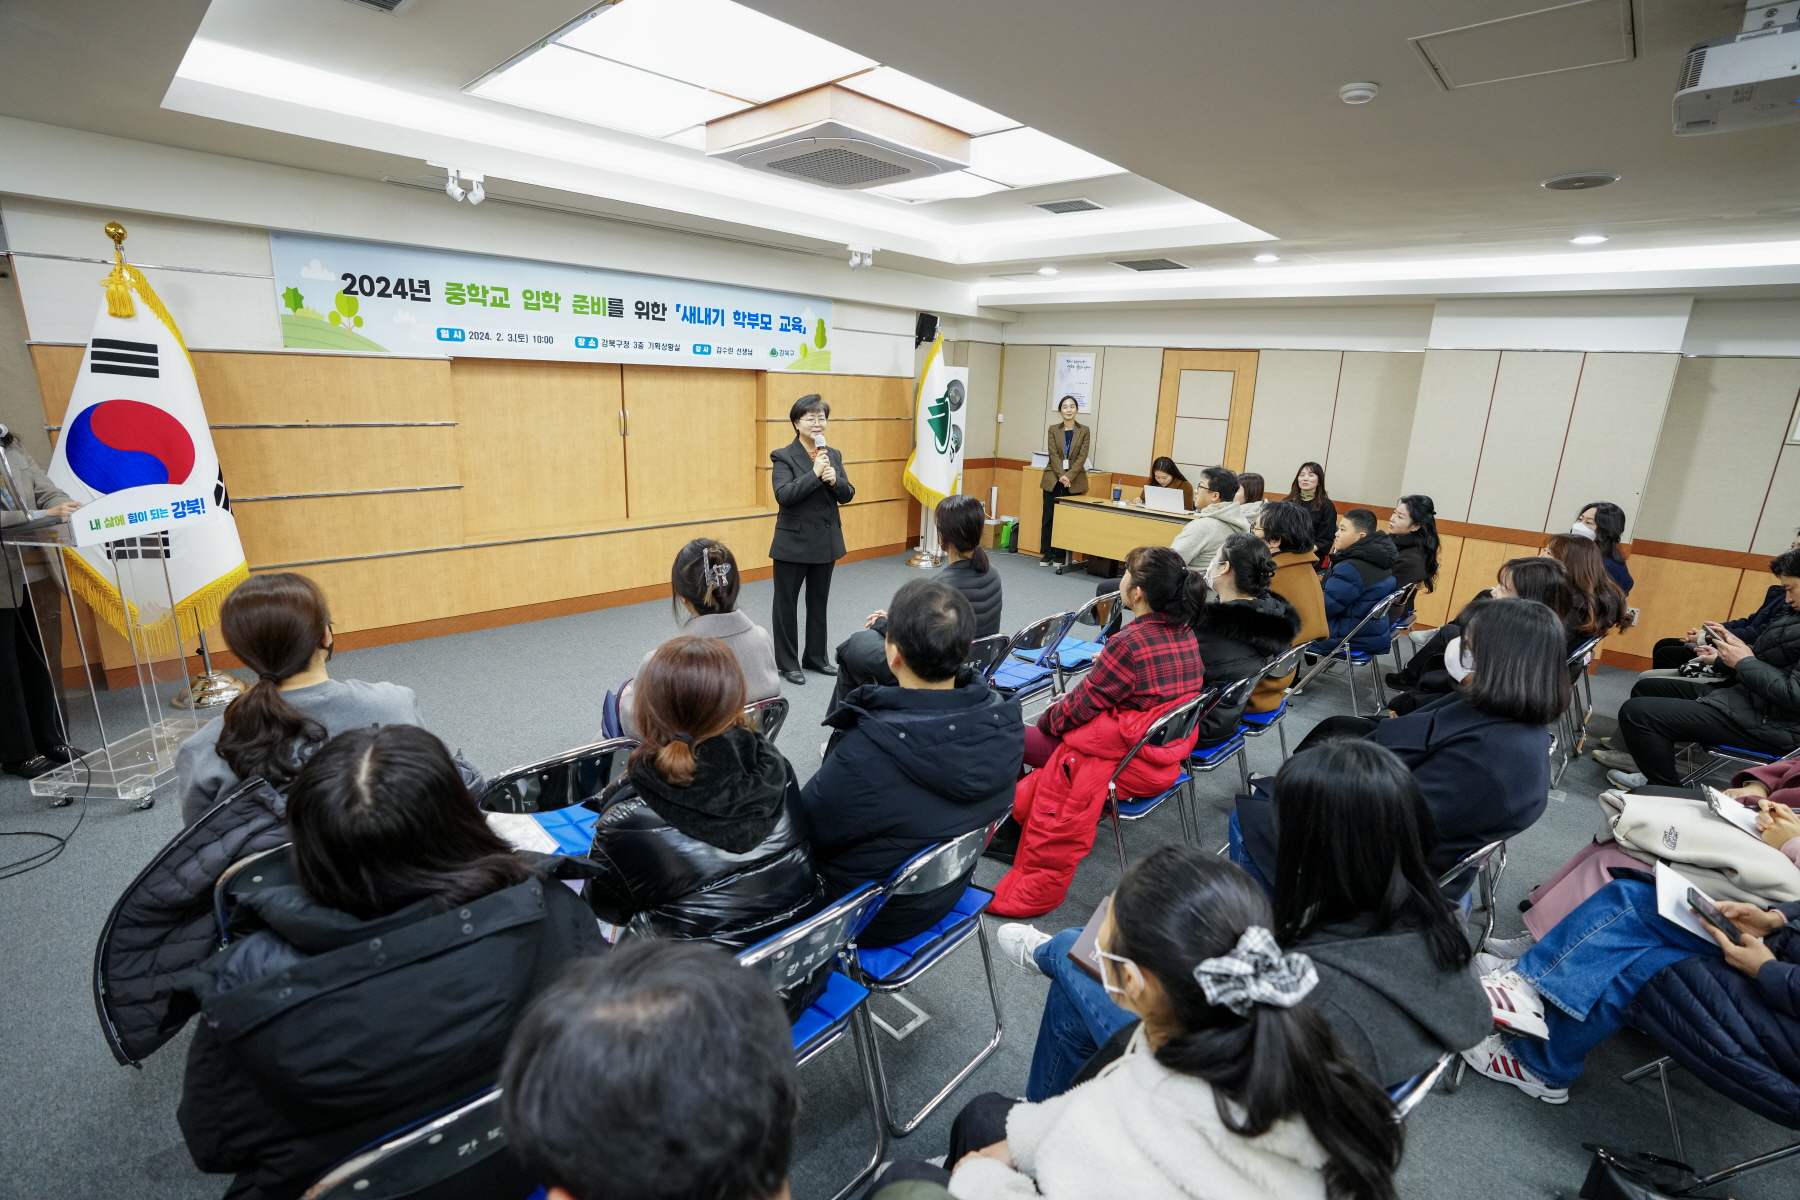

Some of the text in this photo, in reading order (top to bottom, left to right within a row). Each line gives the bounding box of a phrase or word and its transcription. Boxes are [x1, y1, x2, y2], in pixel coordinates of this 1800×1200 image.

[341, 272, 432, 303] 2024년
[444, 281, 511, 309] 중학교
[521, 288, 562, 313] 입학
[572, 294, 625, 318] 준비를
[634, 300, 668, 322] 위한
[732, 309, 773, 331] 학부모
[468, 330, 554, 345] 2024. 2. 3.(토) 10:00
[601, 338, 630, 350] 강북구청
[647, 341, 681, 352] 기획상황실
[736, 348, 753, 356] 선생님
[779, 349, 795, 358] 강북구
[89, 497, 206, 532] 내 삶에 힘이 되는 강북!
